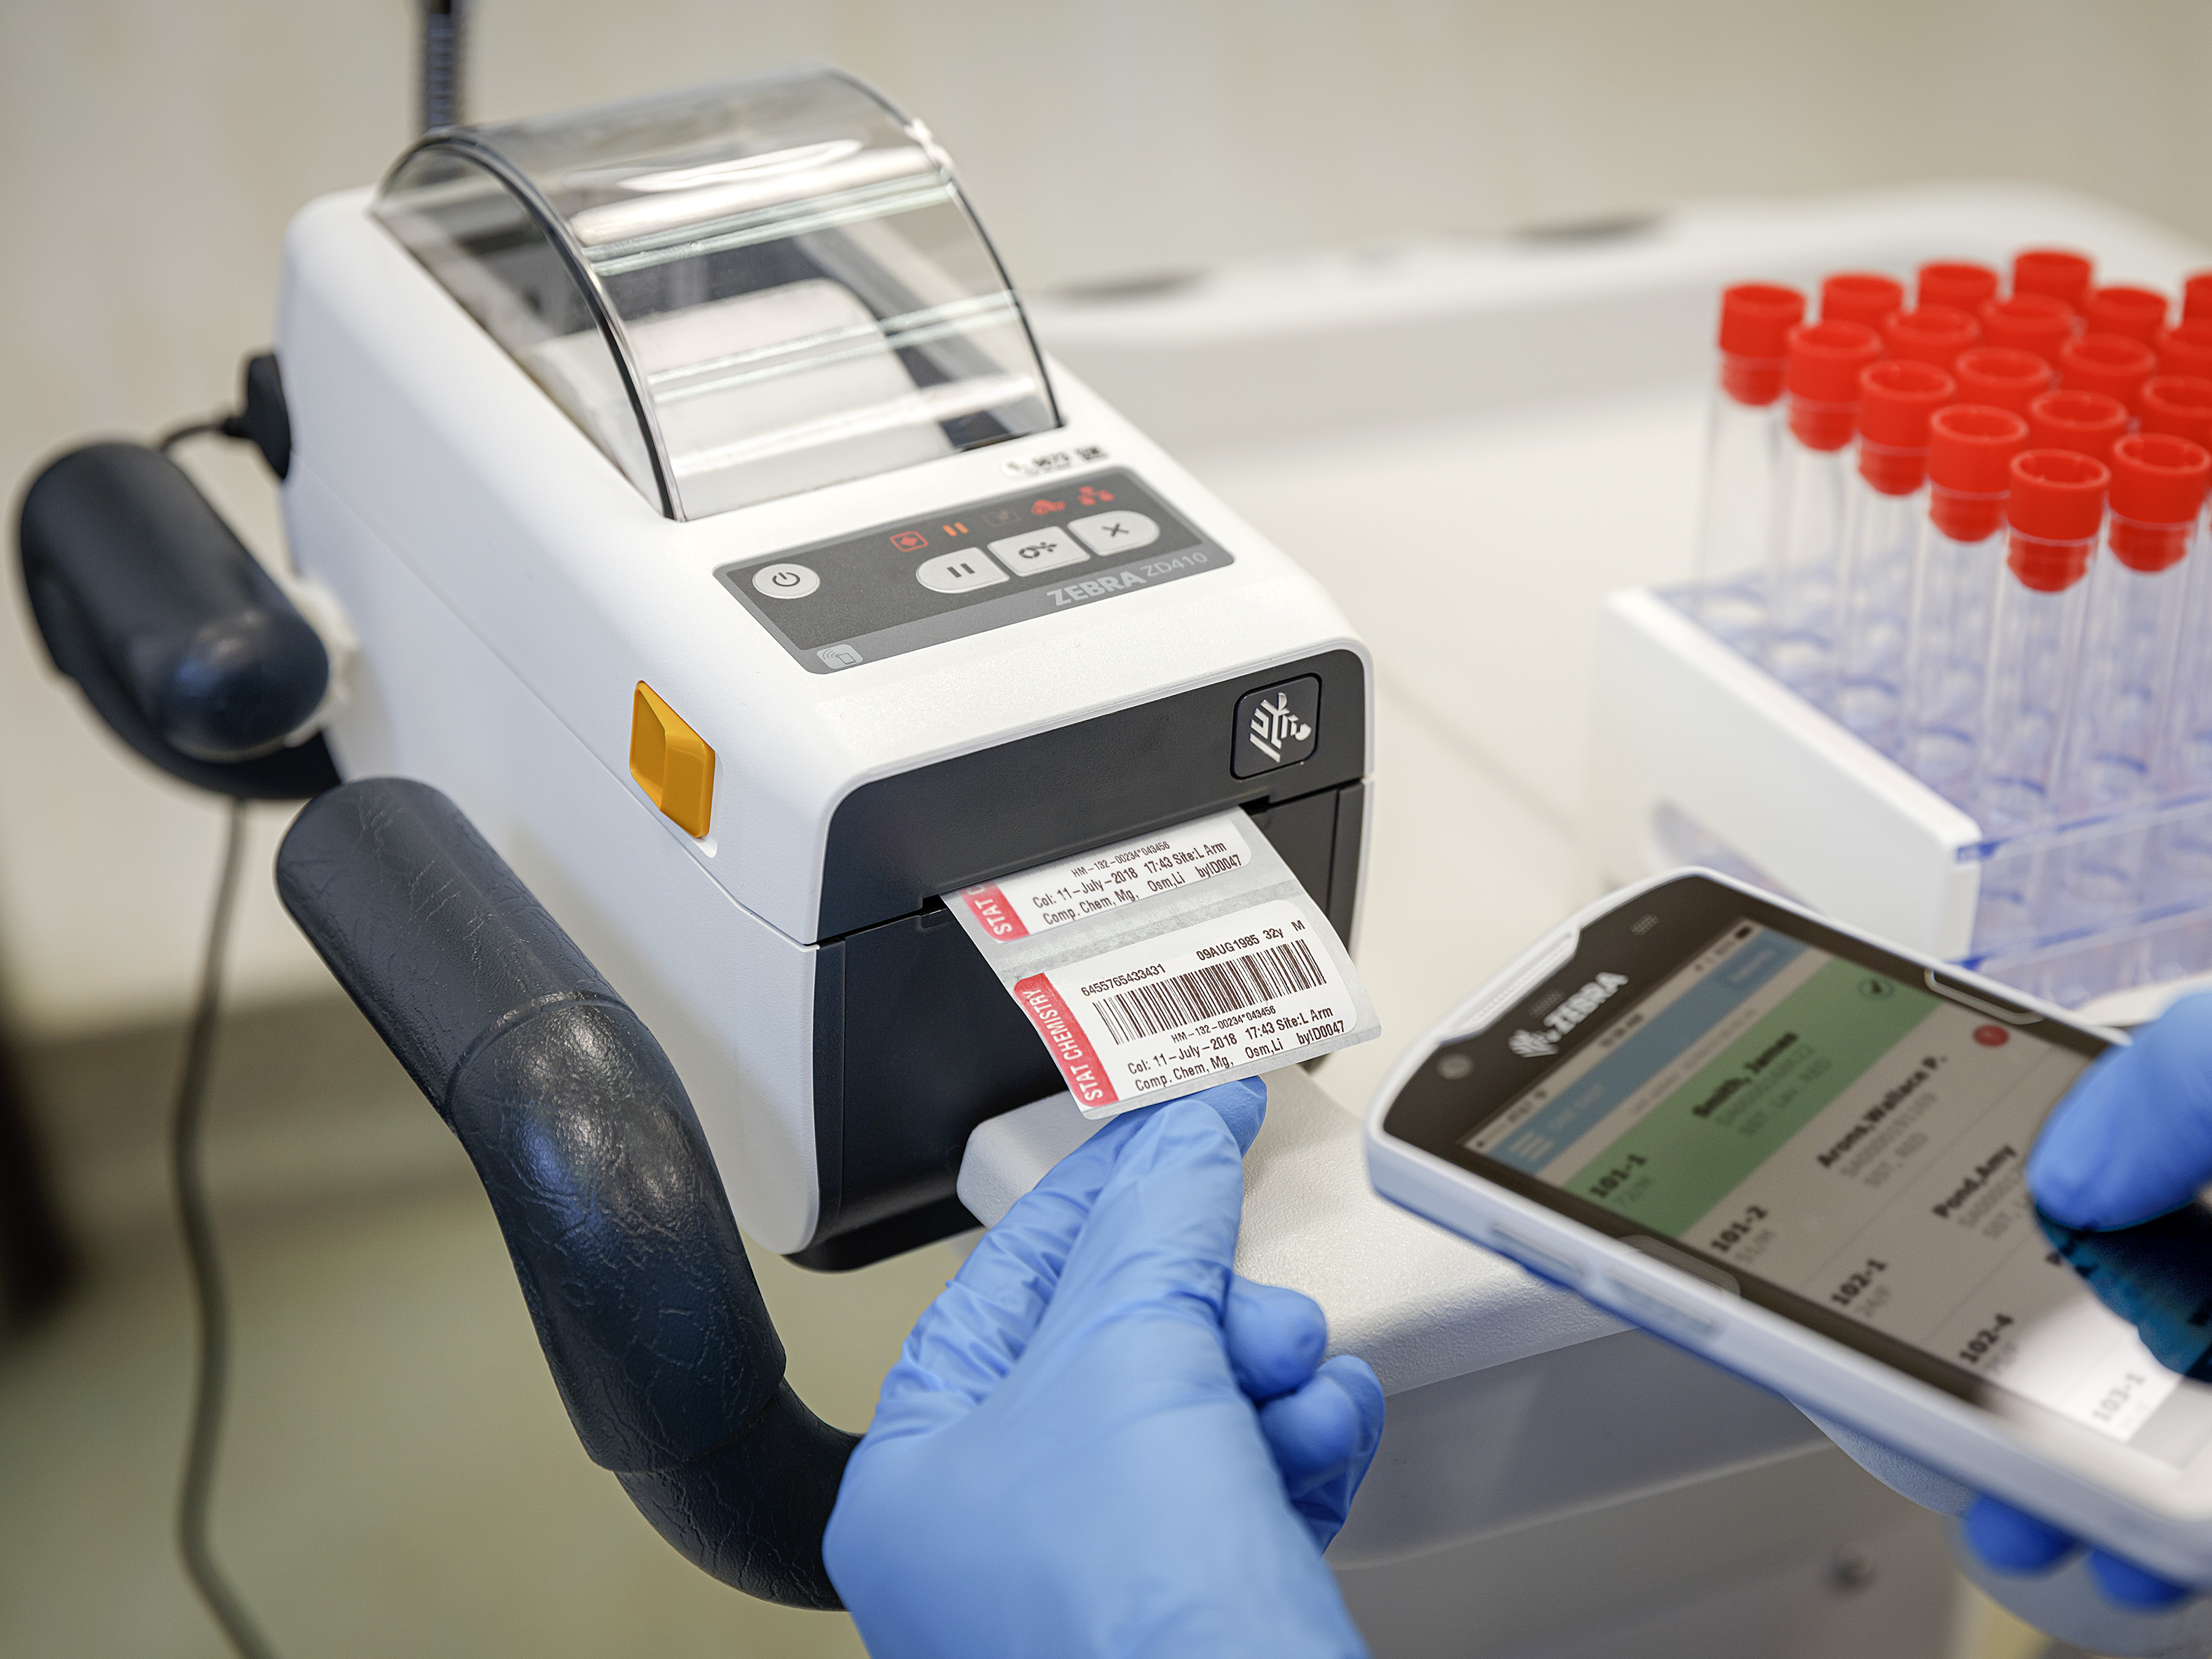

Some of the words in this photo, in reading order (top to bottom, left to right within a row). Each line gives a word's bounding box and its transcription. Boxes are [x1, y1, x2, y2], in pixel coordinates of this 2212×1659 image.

[1046, 571, 1147, 606] ZEBRA
[1140, 552, 1207, 577] ZD410
[1033, 893, 1057, 908] Col:
[1143, 857, 1174, 874] 17:43
[1203, 841, 1228, 856] Arm
[1043, 909, 1080, 925] Comp.
[1079, 896, 1117, 914] Chem,
[1114, 889, 1140, 903] Mg,
[1194, 853, 1242, 878] byID0047
[975, 898, 1013, 935] STAT
[1081, 963, 1166, 997] 6455765433431
[1196, 935, 1260, 961] 09AUG1985
[1263, 927, 1284, 940] 32y
[1291, 920, 1306, 932] M
[1022, 989, 1083, 1061] CHEMISTRY
[1543, 971, 1628, 1035] ZEBRA
[1128, 1059, 1151, 1074] Col:
[1245, 1022, 1276, 1040] 17:43
[1310, 1007, 1334, 1021] Arm
[1135, 1075, 1172, 1091] Comp.
[1173, 1064, 1210, 1080] Chem,
[1210, 1056, 1234, 1069] Mg,
[1296, 1020, 1345, 1045] byID0047
[1070, 1065, 1104, 1101] STAT
[1590, 1153, 1647, 1198] 101-1
[1711, 1204, 1768, 1252] 101-2
[1831, 1260, 1886, 1305] 102-1
[1959, 1314, 2014, 1363] 102-4
